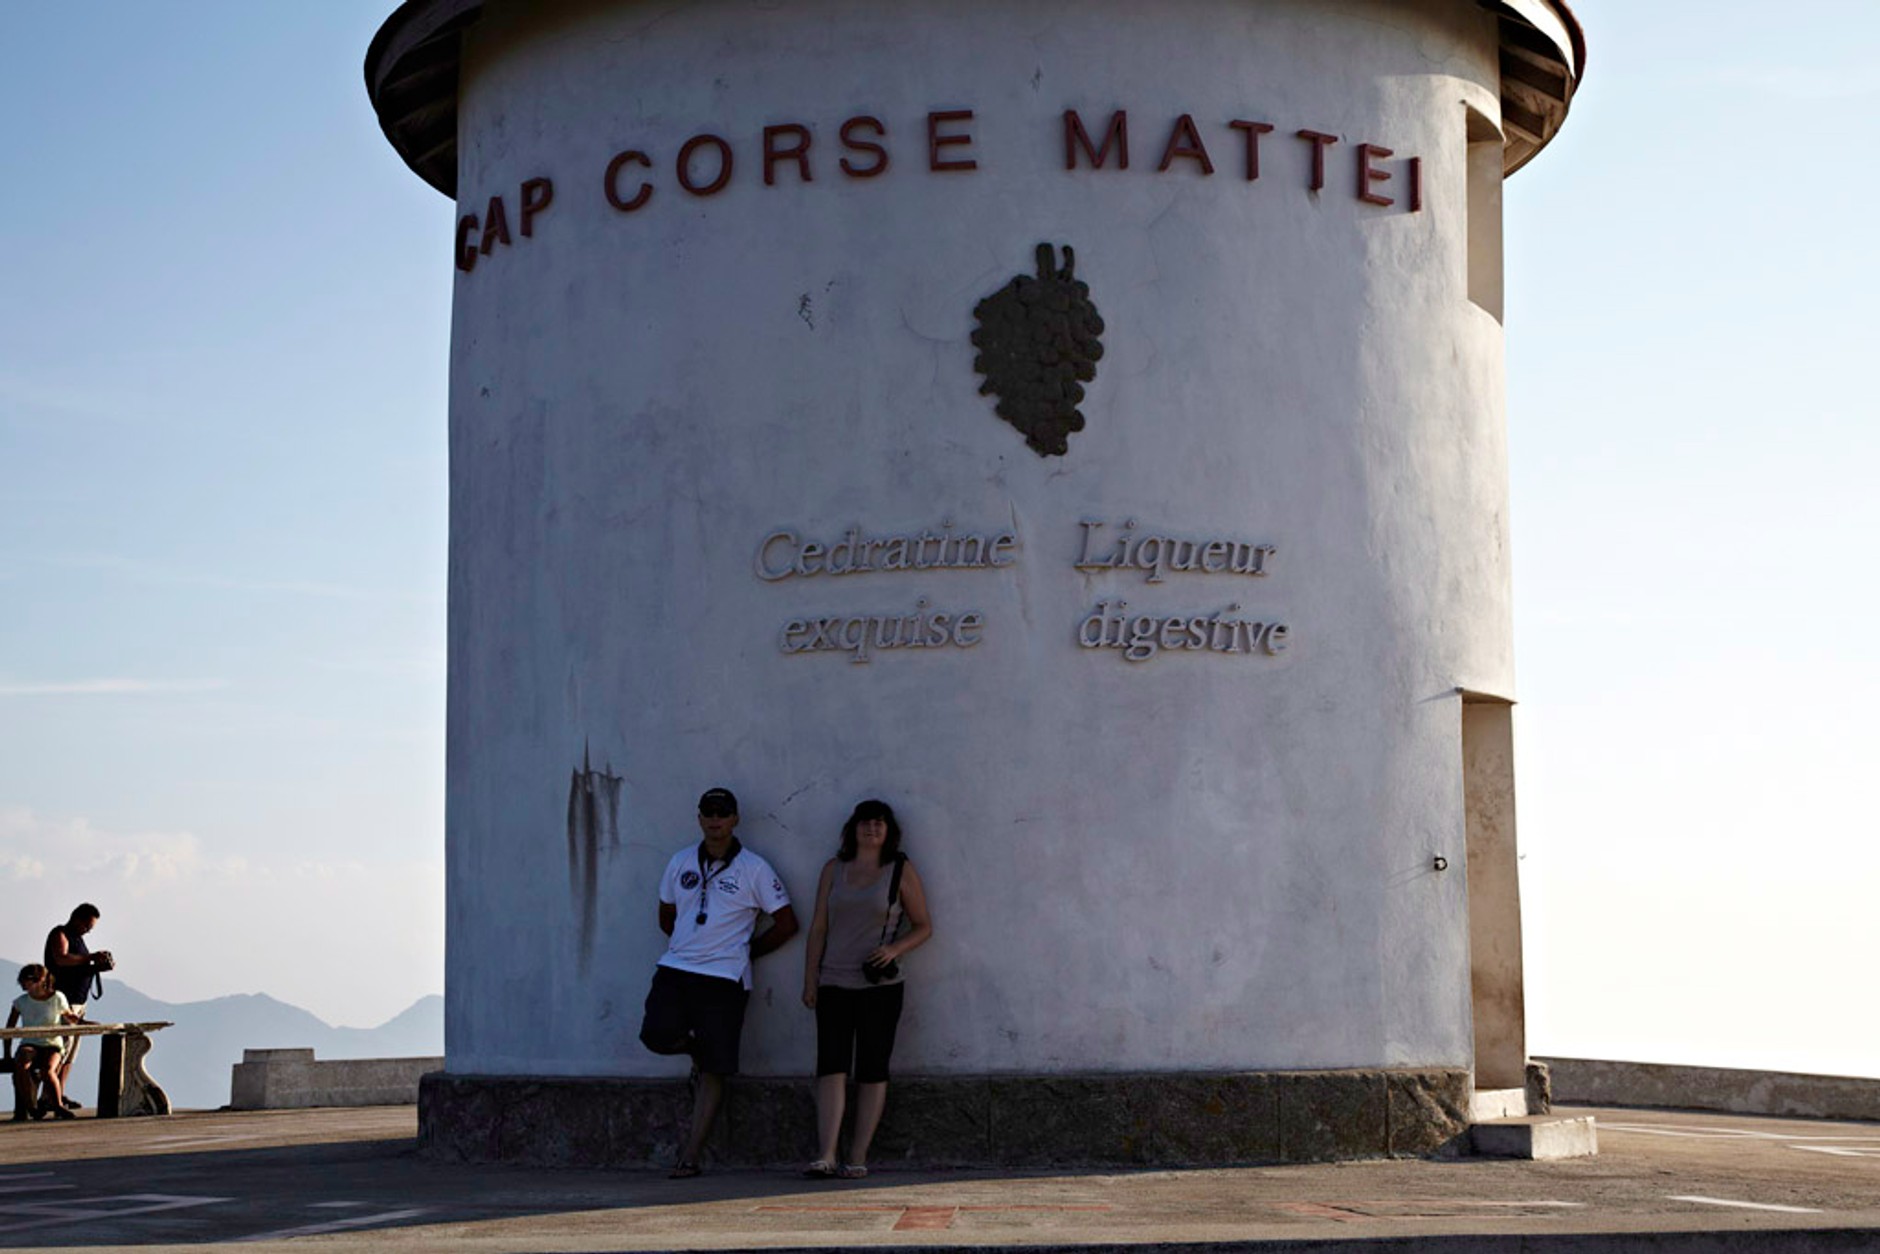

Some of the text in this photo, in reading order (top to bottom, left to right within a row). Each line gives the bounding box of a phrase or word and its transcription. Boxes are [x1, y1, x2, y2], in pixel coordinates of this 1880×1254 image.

[455, 109, 1422, 273] CAP CORSE MATTEI
[753, 517, 1278, 583] Cedratine Liqueur
[778, 599, 1292, 663] exquise digestive
